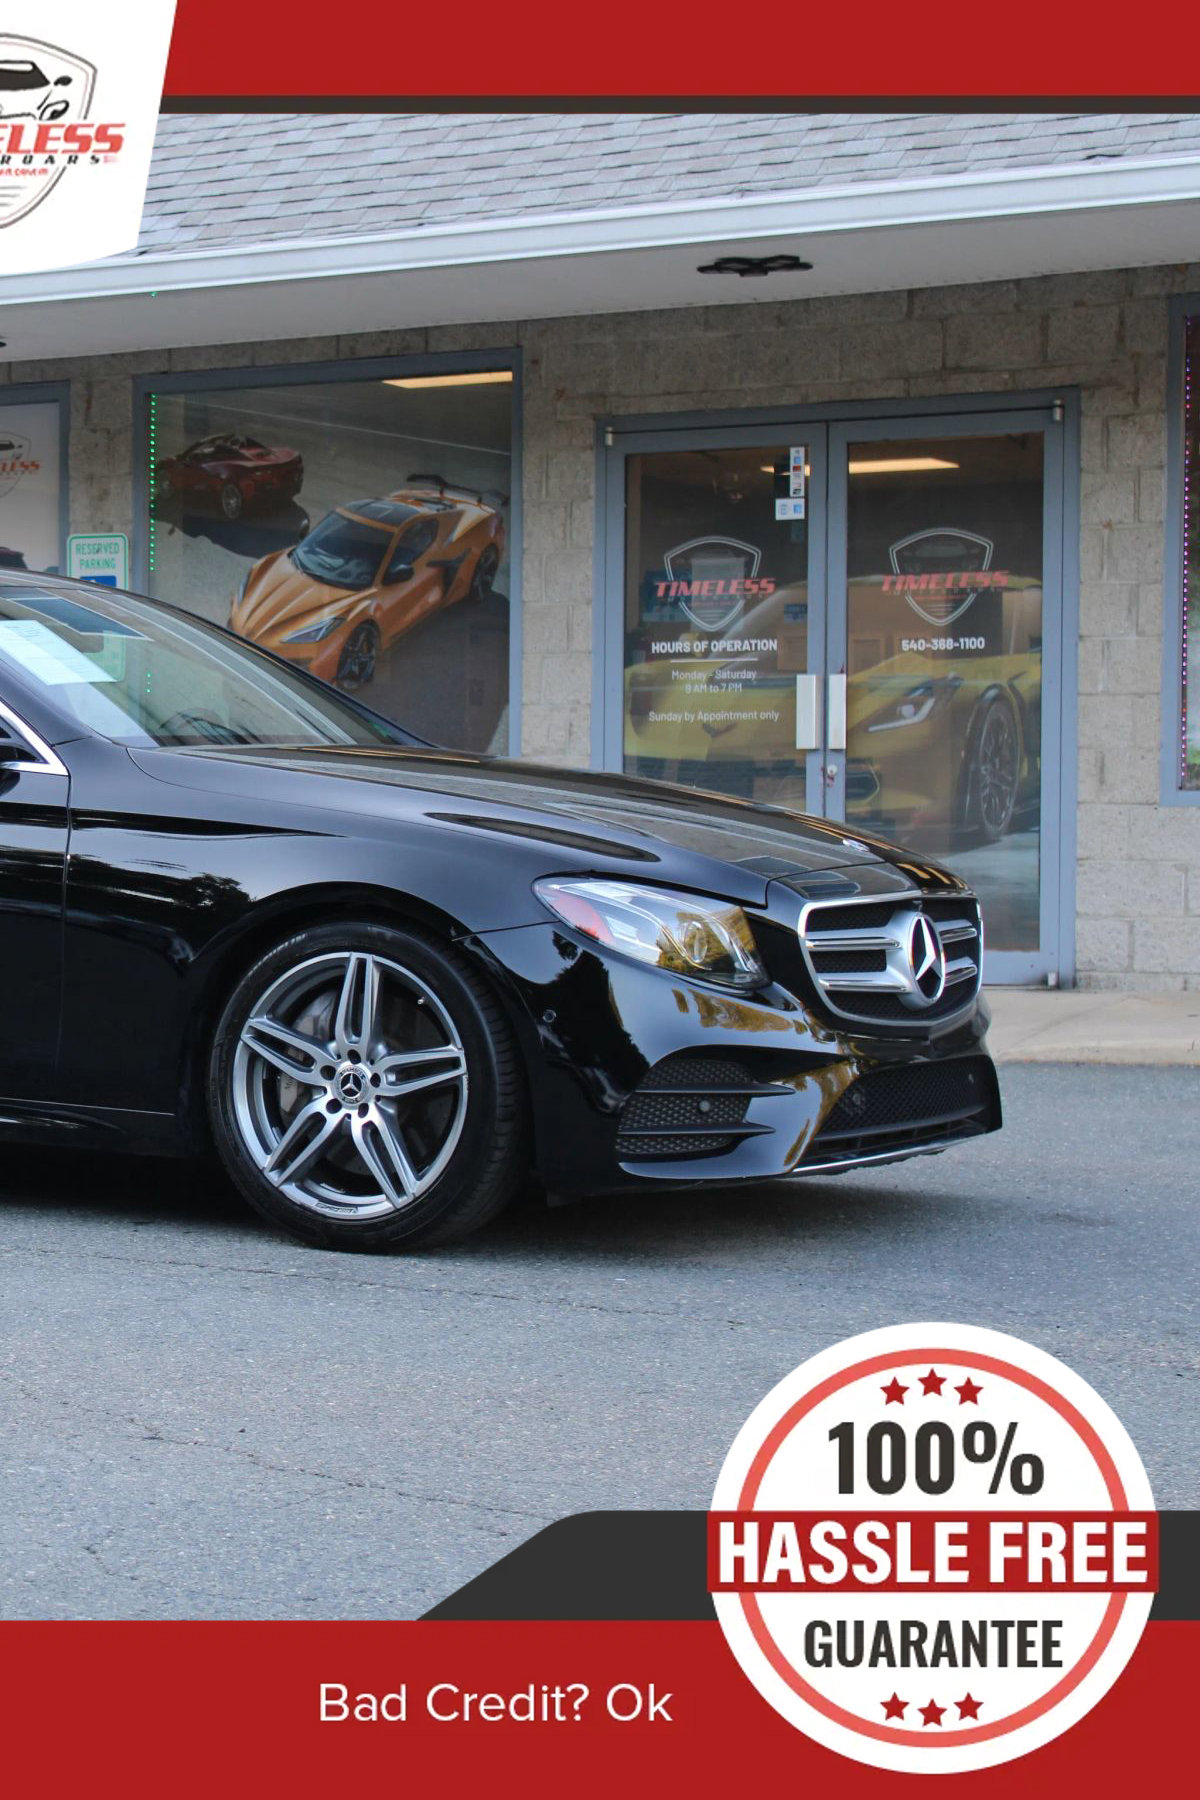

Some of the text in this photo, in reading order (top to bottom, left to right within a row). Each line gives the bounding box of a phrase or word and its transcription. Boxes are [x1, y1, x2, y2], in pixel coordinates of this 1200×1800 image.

[75, 542, 120, 556] RESERVED
[79, 558, 116, 569] PARKING
[654, 577, 776, 598] TIMELESS
[881, 569, 1010, 592] TIMELESS
[651, 638, 778, 654] HOURS OF OPERATION
[900, 636, 986, 652] 540-368-1100
[671, 669, 708, 682] Monday
[714, 668, 757, 682] Saturday
[693, 683, 708, 693] AM
[709, 683, 720, 693] to
[720, 682, 728, 692] 7
[728, 682, 743, 693] PM
[648, 710, 780, 723] Sunday by Appointment only
